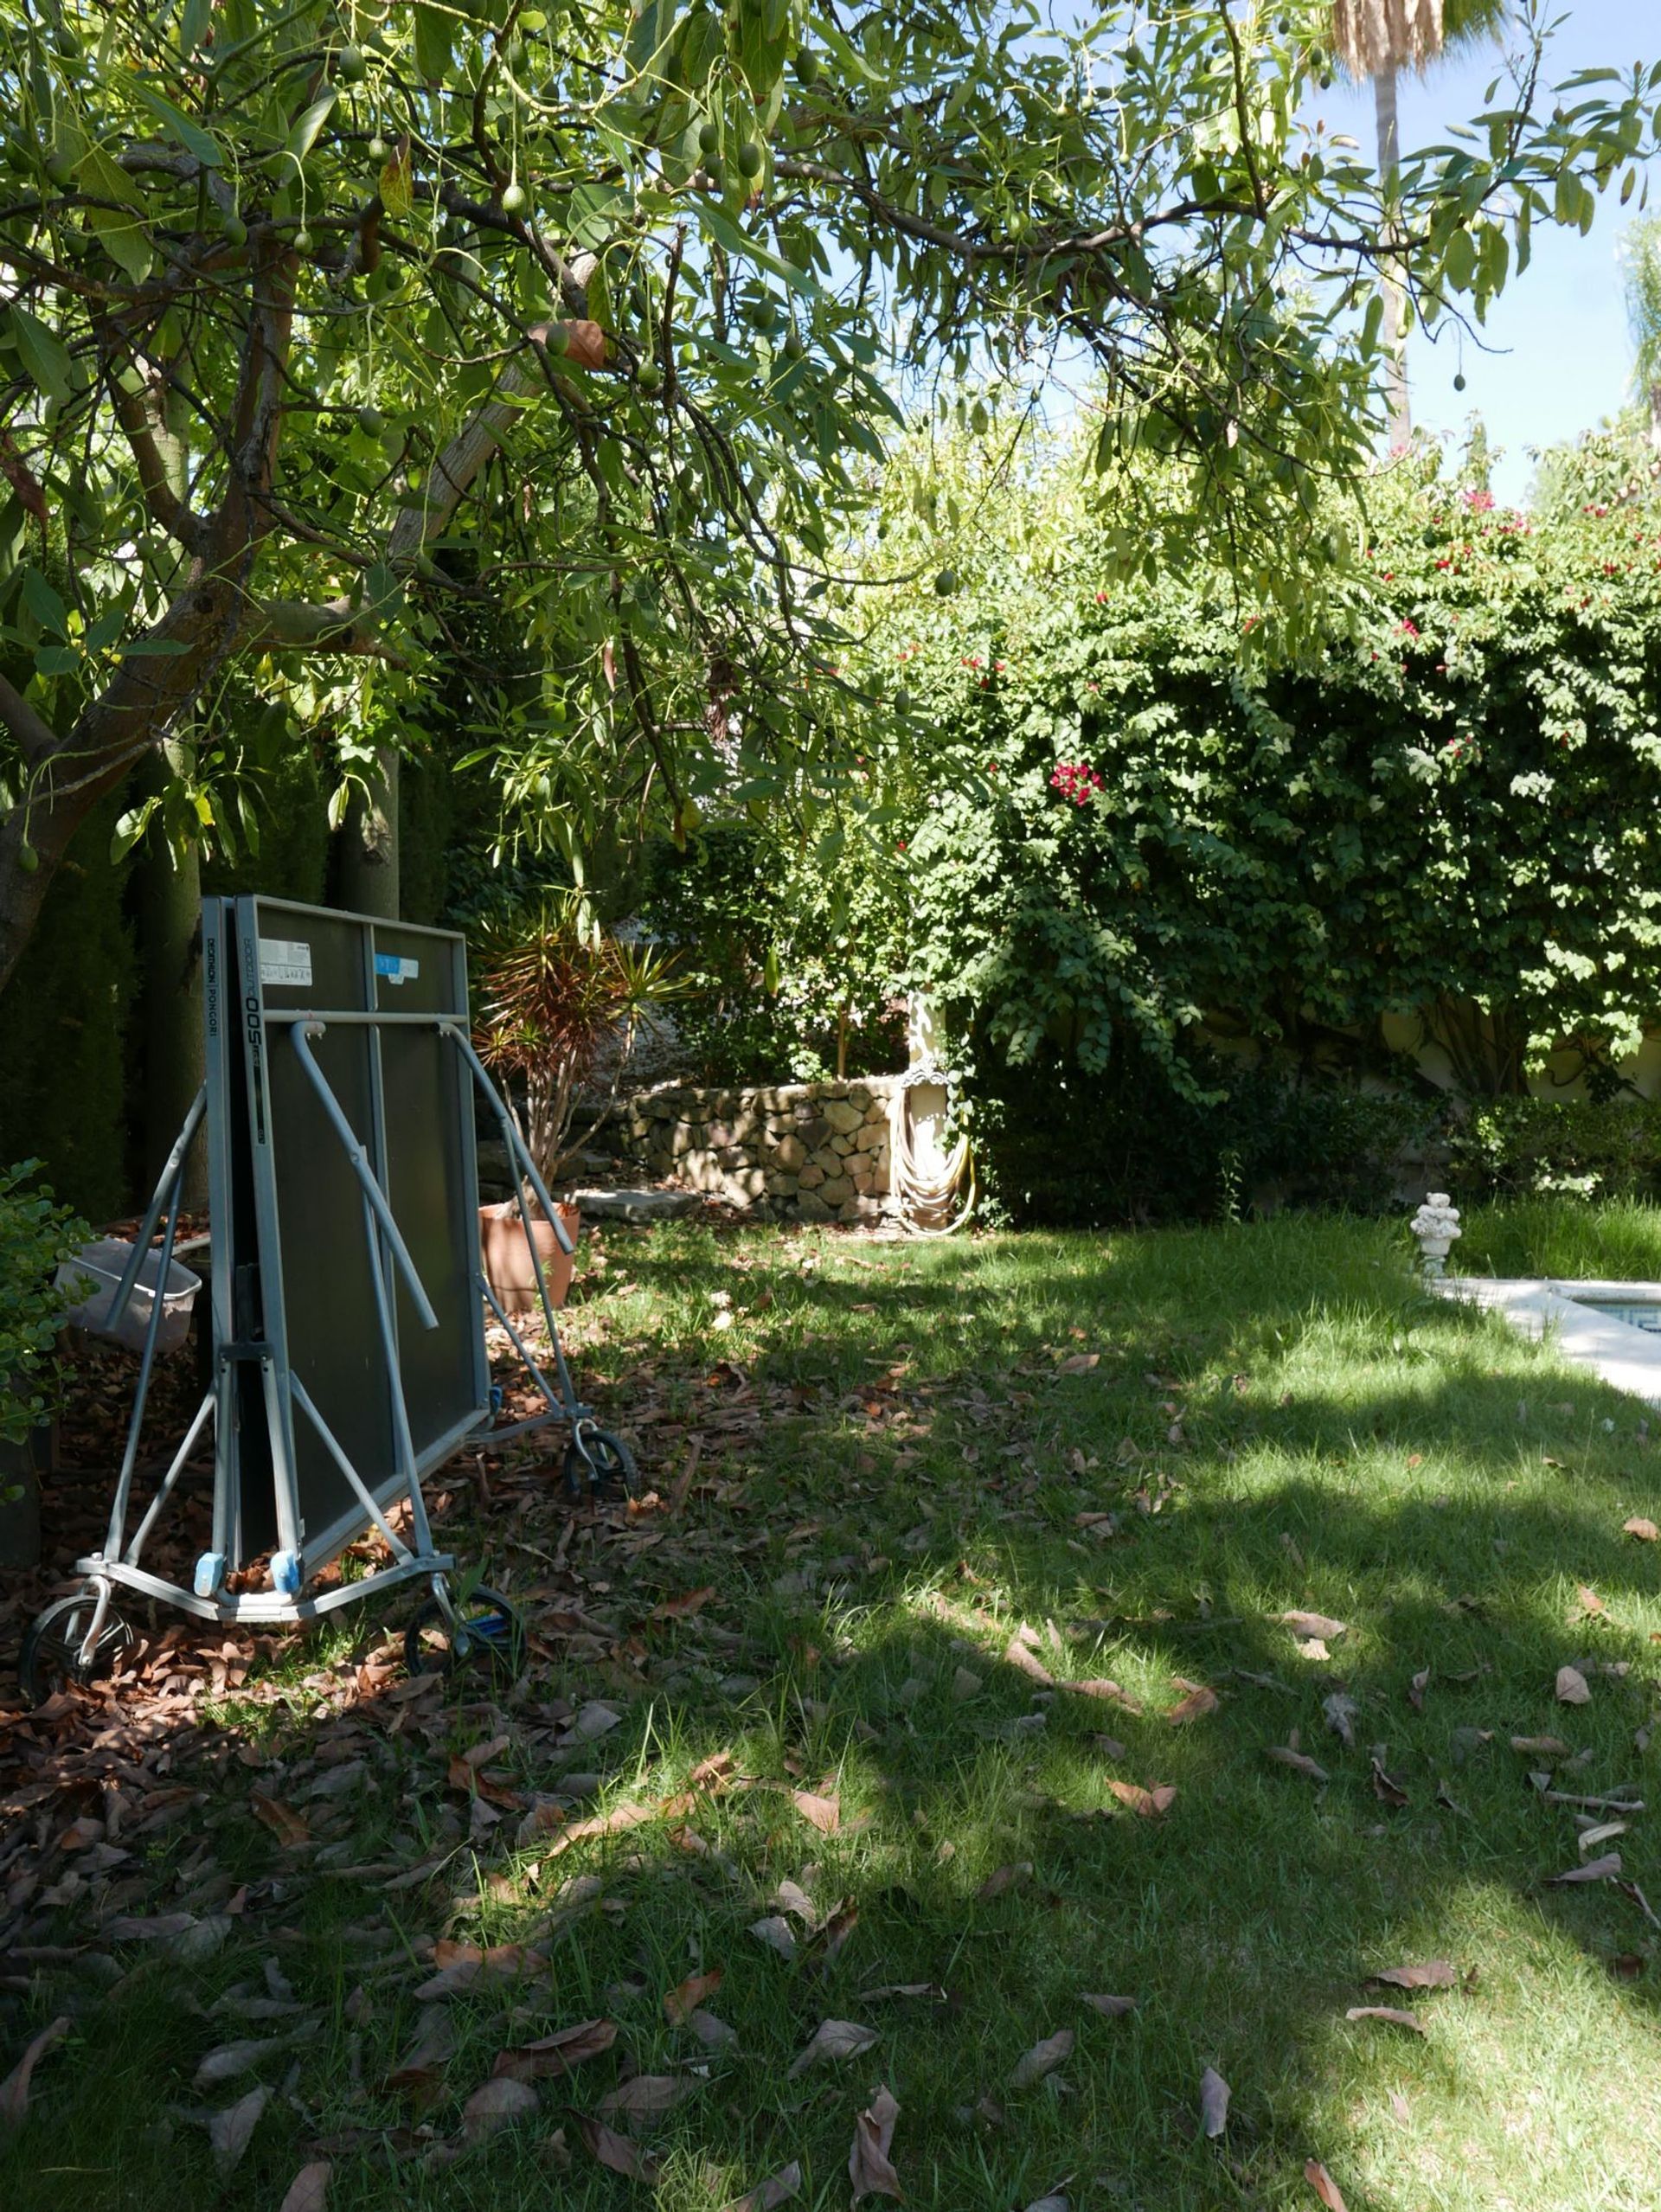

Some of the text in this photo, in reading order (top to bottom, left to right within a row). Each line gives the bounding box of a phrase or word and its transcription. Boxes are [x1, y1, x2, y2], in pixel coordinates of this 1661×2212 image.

[244, 939, 255, 997] OUTDOOR
[208, 989, 217, 1036] PONGORI
[246, 997, 261, 1045] 500
